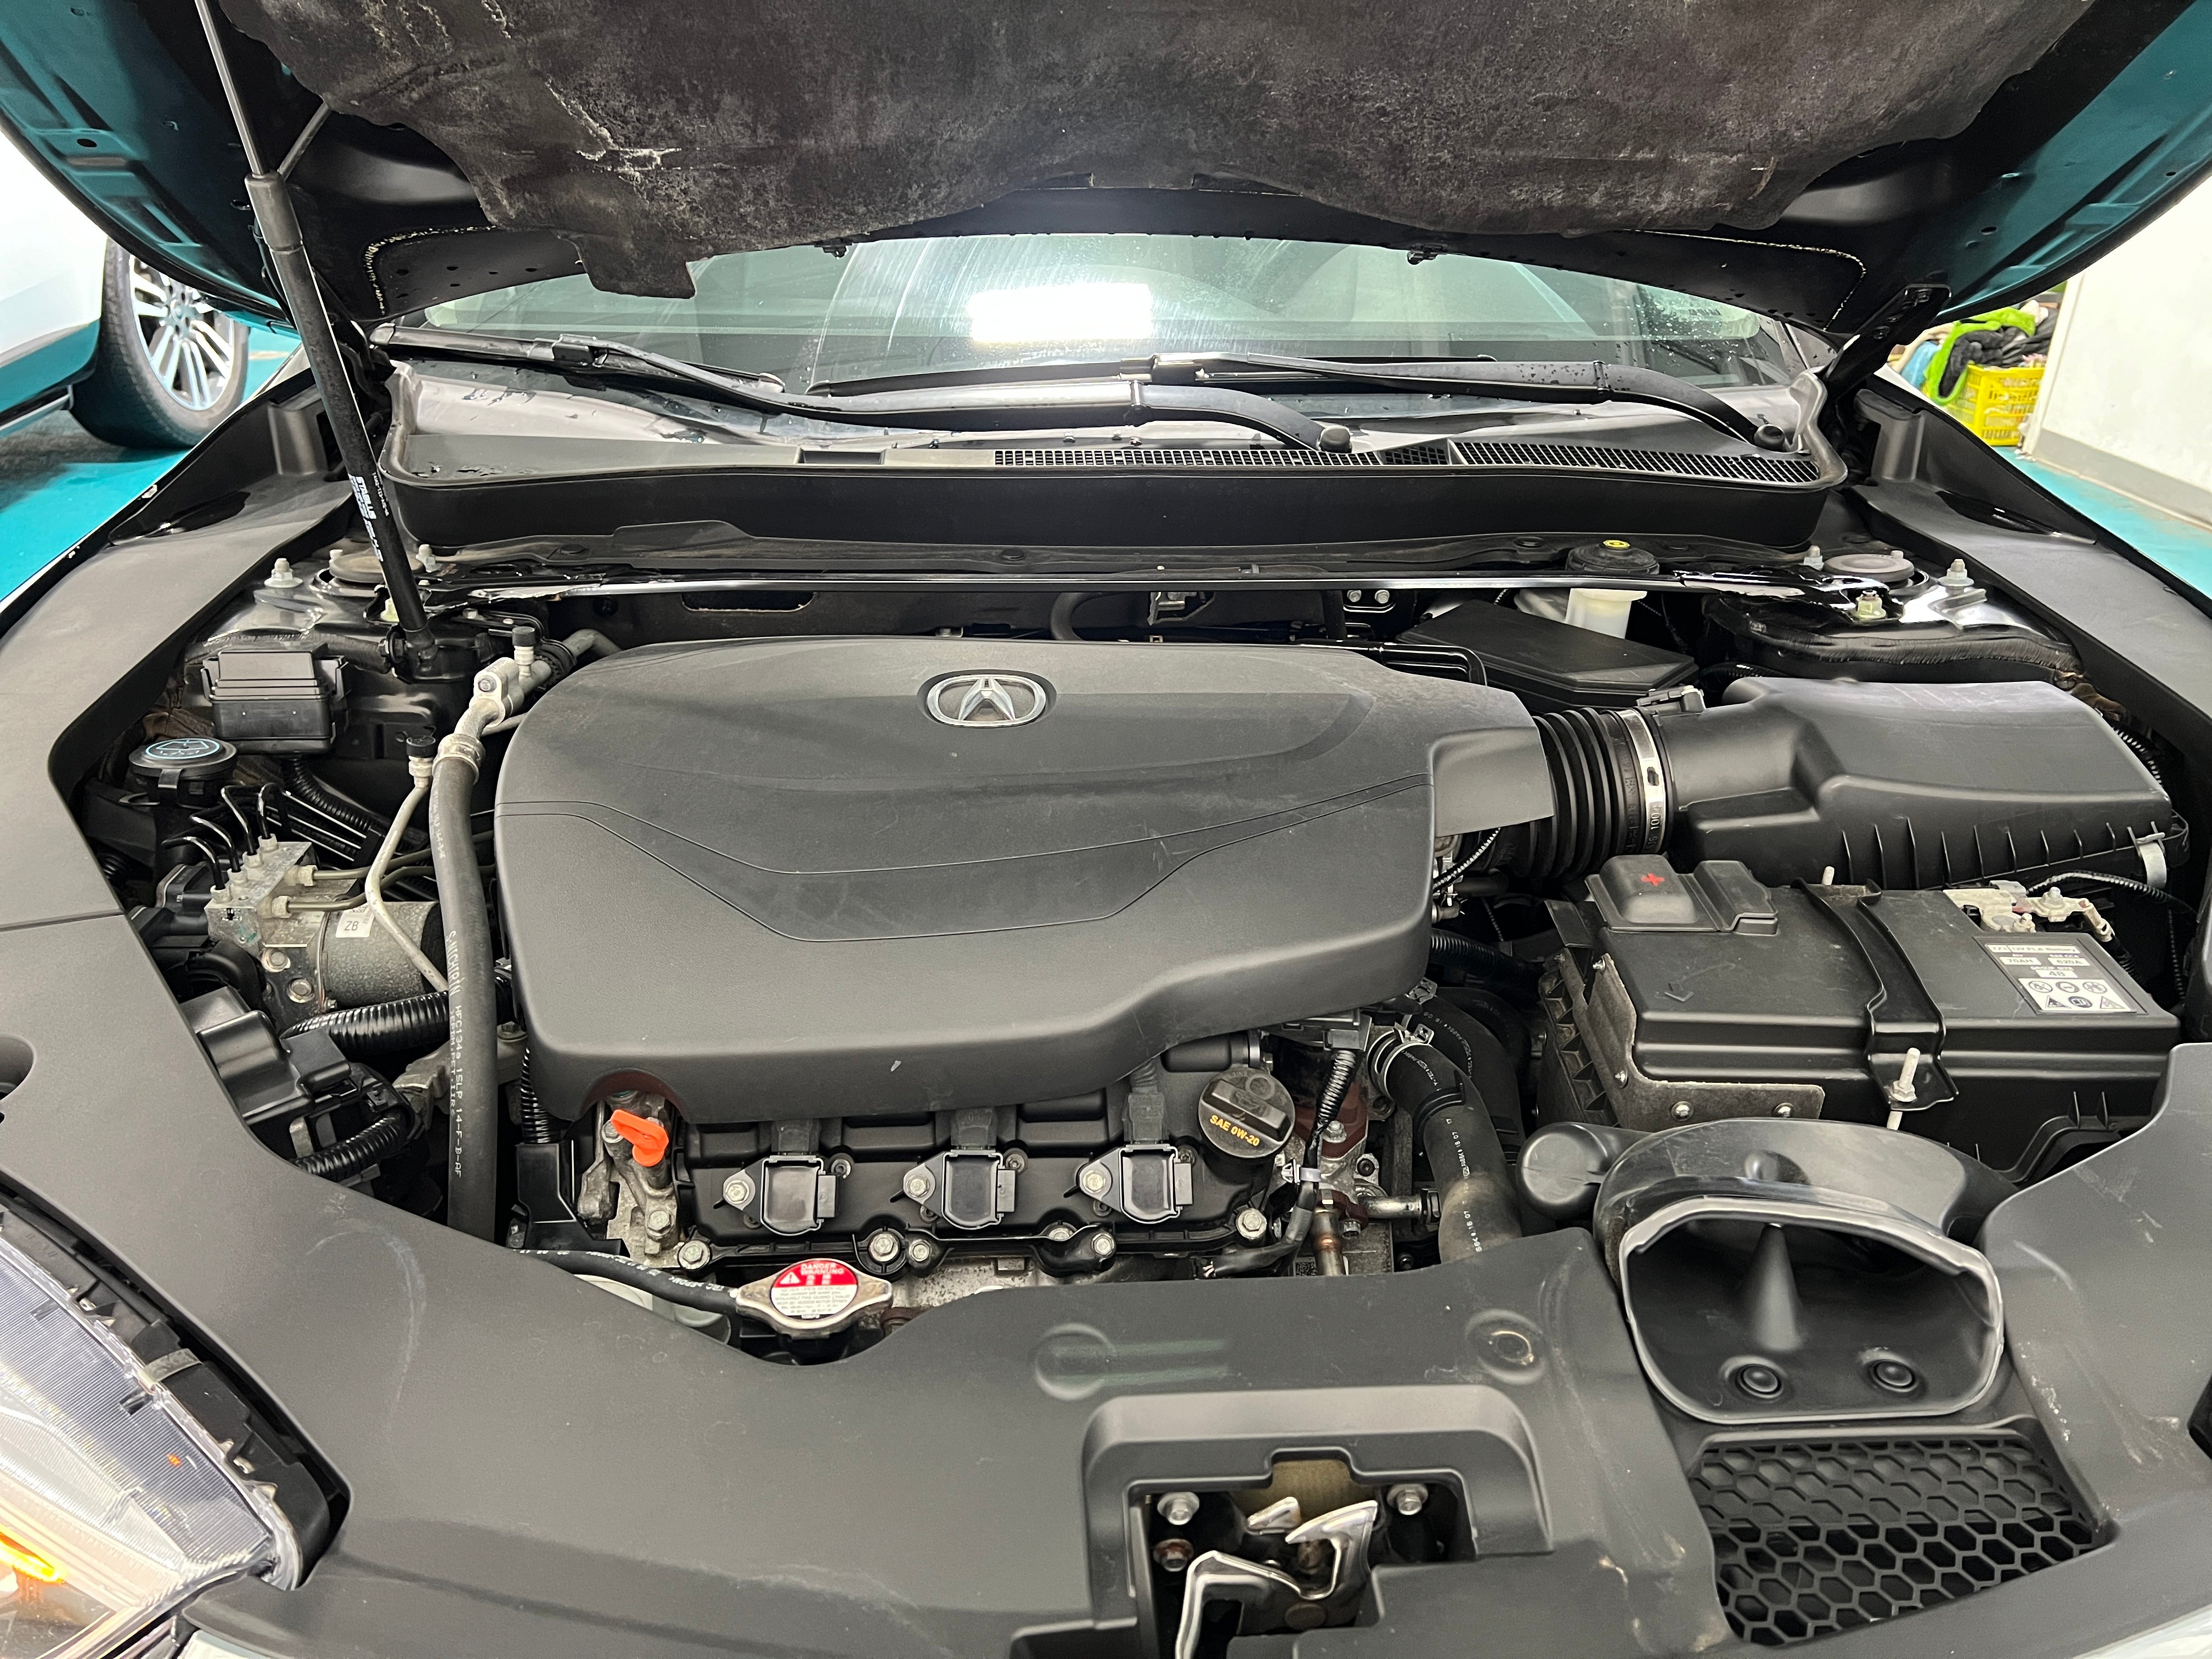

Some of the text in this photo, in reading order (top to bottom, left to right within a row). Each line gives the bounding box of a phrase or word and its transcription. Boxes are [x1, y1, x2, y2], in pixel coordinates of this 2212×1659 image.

[344, 921, 359, 931] ZB
[1210, 1114, 1260, 1147] SAE 0W-20
